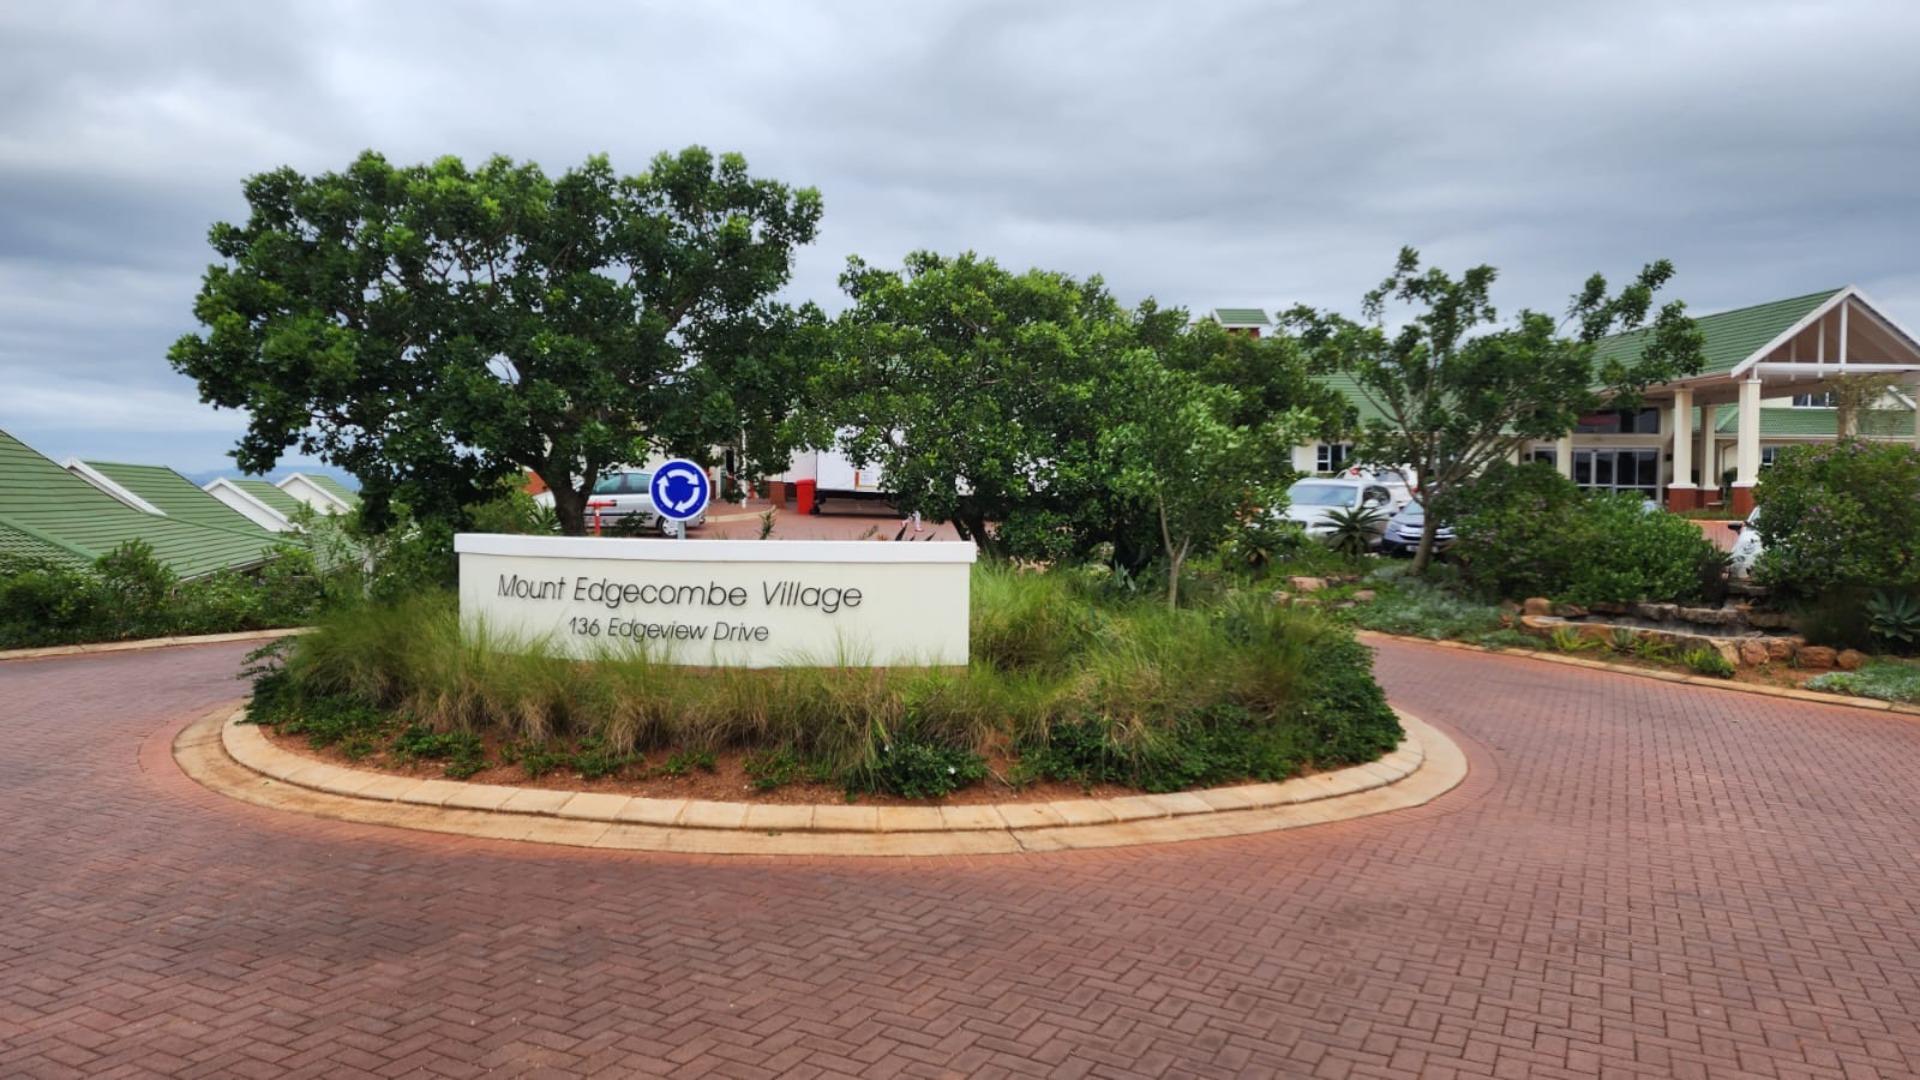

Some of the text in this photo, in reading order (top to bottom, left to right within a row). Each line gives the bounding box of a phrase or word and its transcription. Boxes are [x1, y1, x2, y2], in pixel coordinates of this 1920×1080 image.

[497, 573, 863, 614] Mount Edgecombe Village
[569, 616, 769, 642] 136 Edgeview Drive
